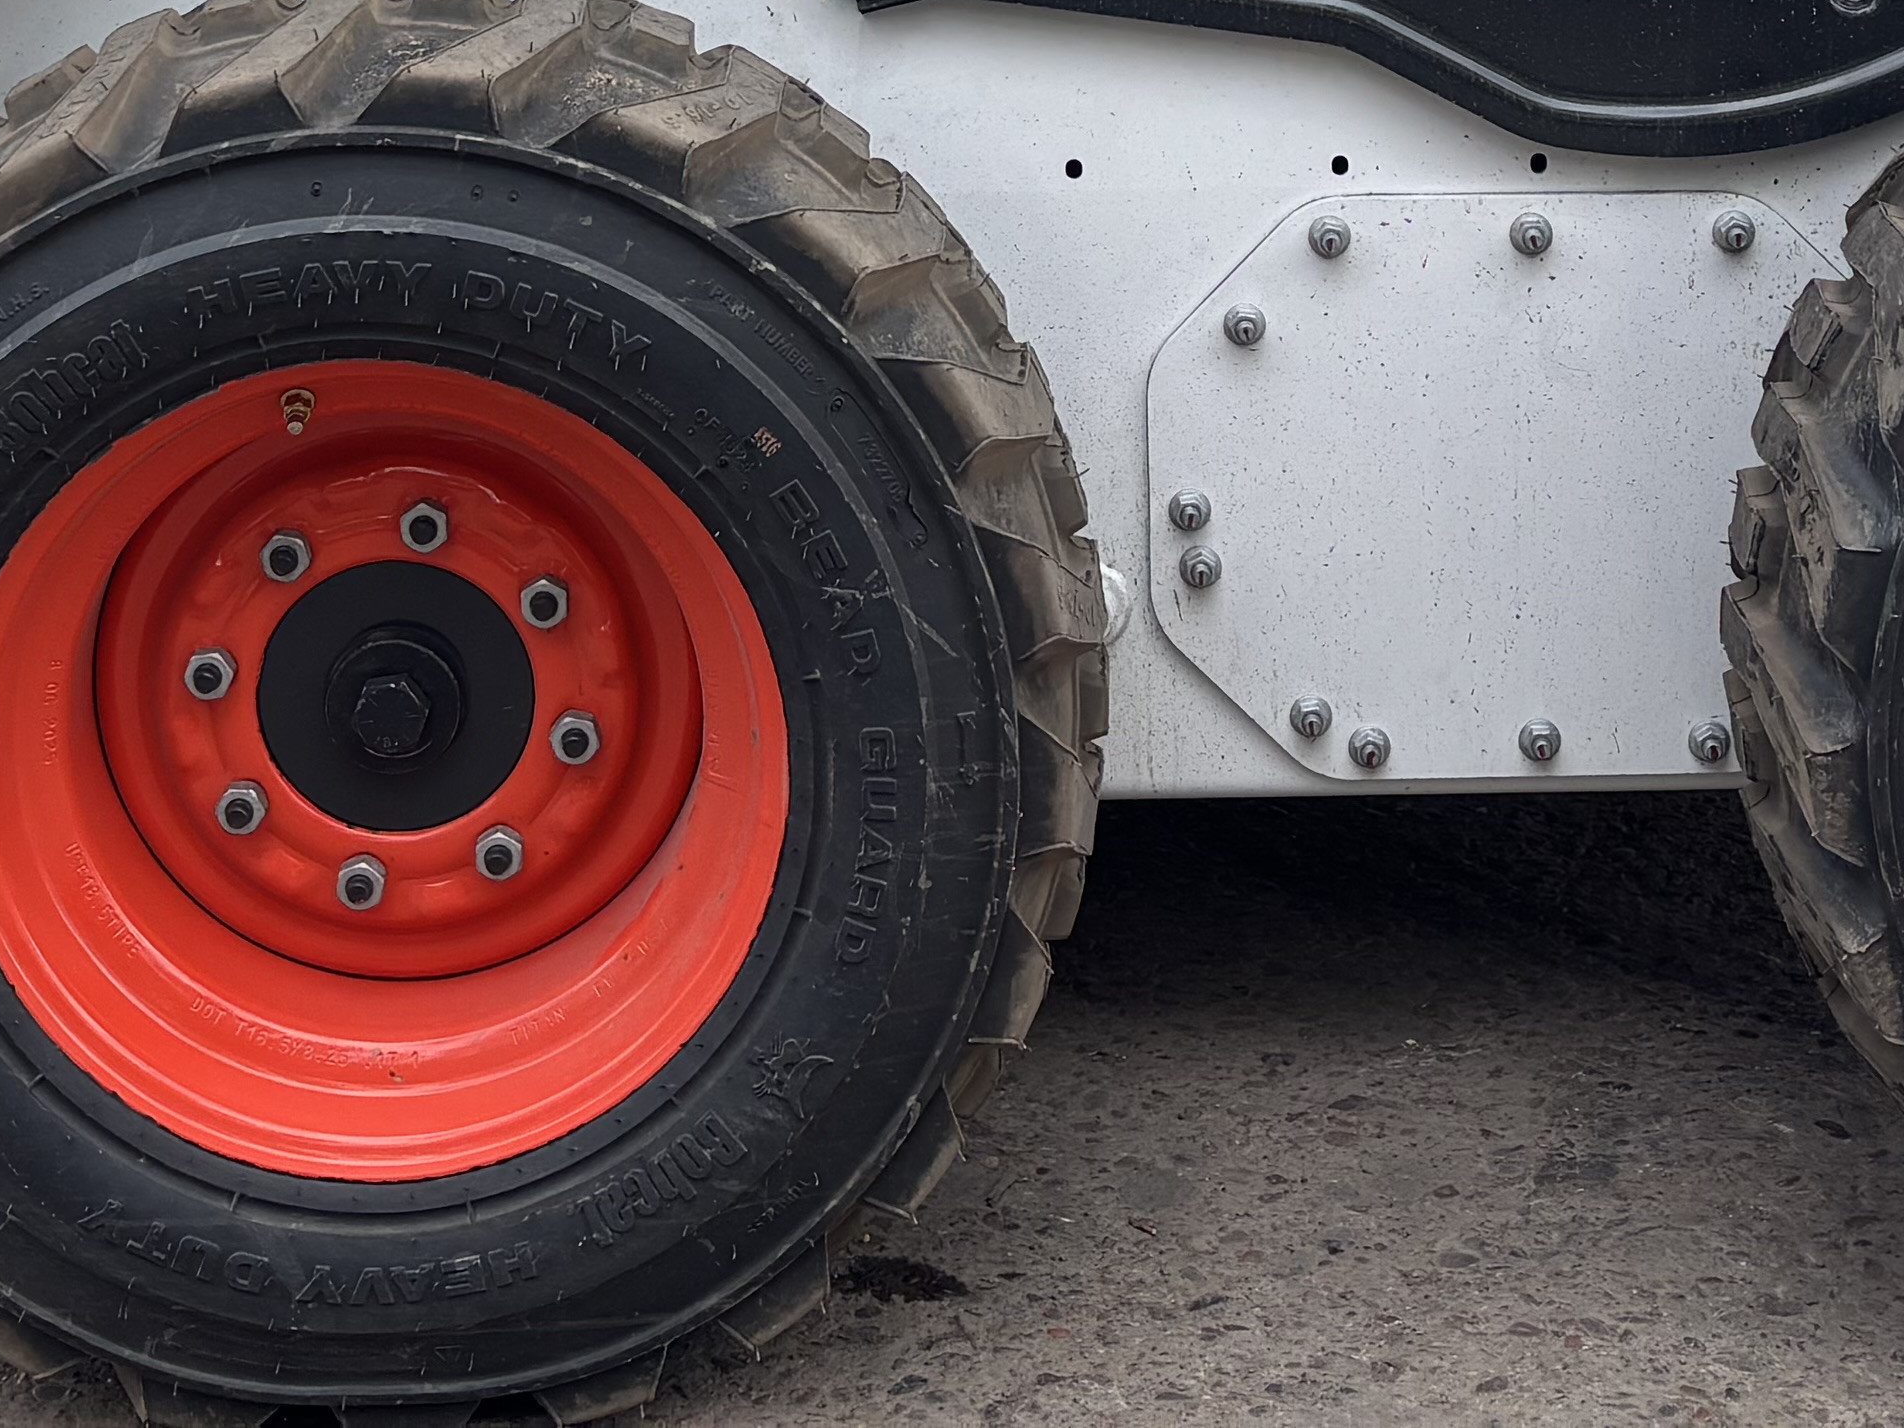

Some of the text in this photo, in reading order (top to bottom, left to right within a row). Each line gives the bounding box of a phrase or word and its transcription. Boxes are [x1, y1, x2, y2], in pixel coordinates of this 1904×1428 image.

[183, 254, 655, 377] HEAVY DUTY
[767, 471, 904, 970] BEAD GUARD
[190, 995, 226, 1027] DOT
[75, 1188, 540, 1306] HEAVY DUTY
